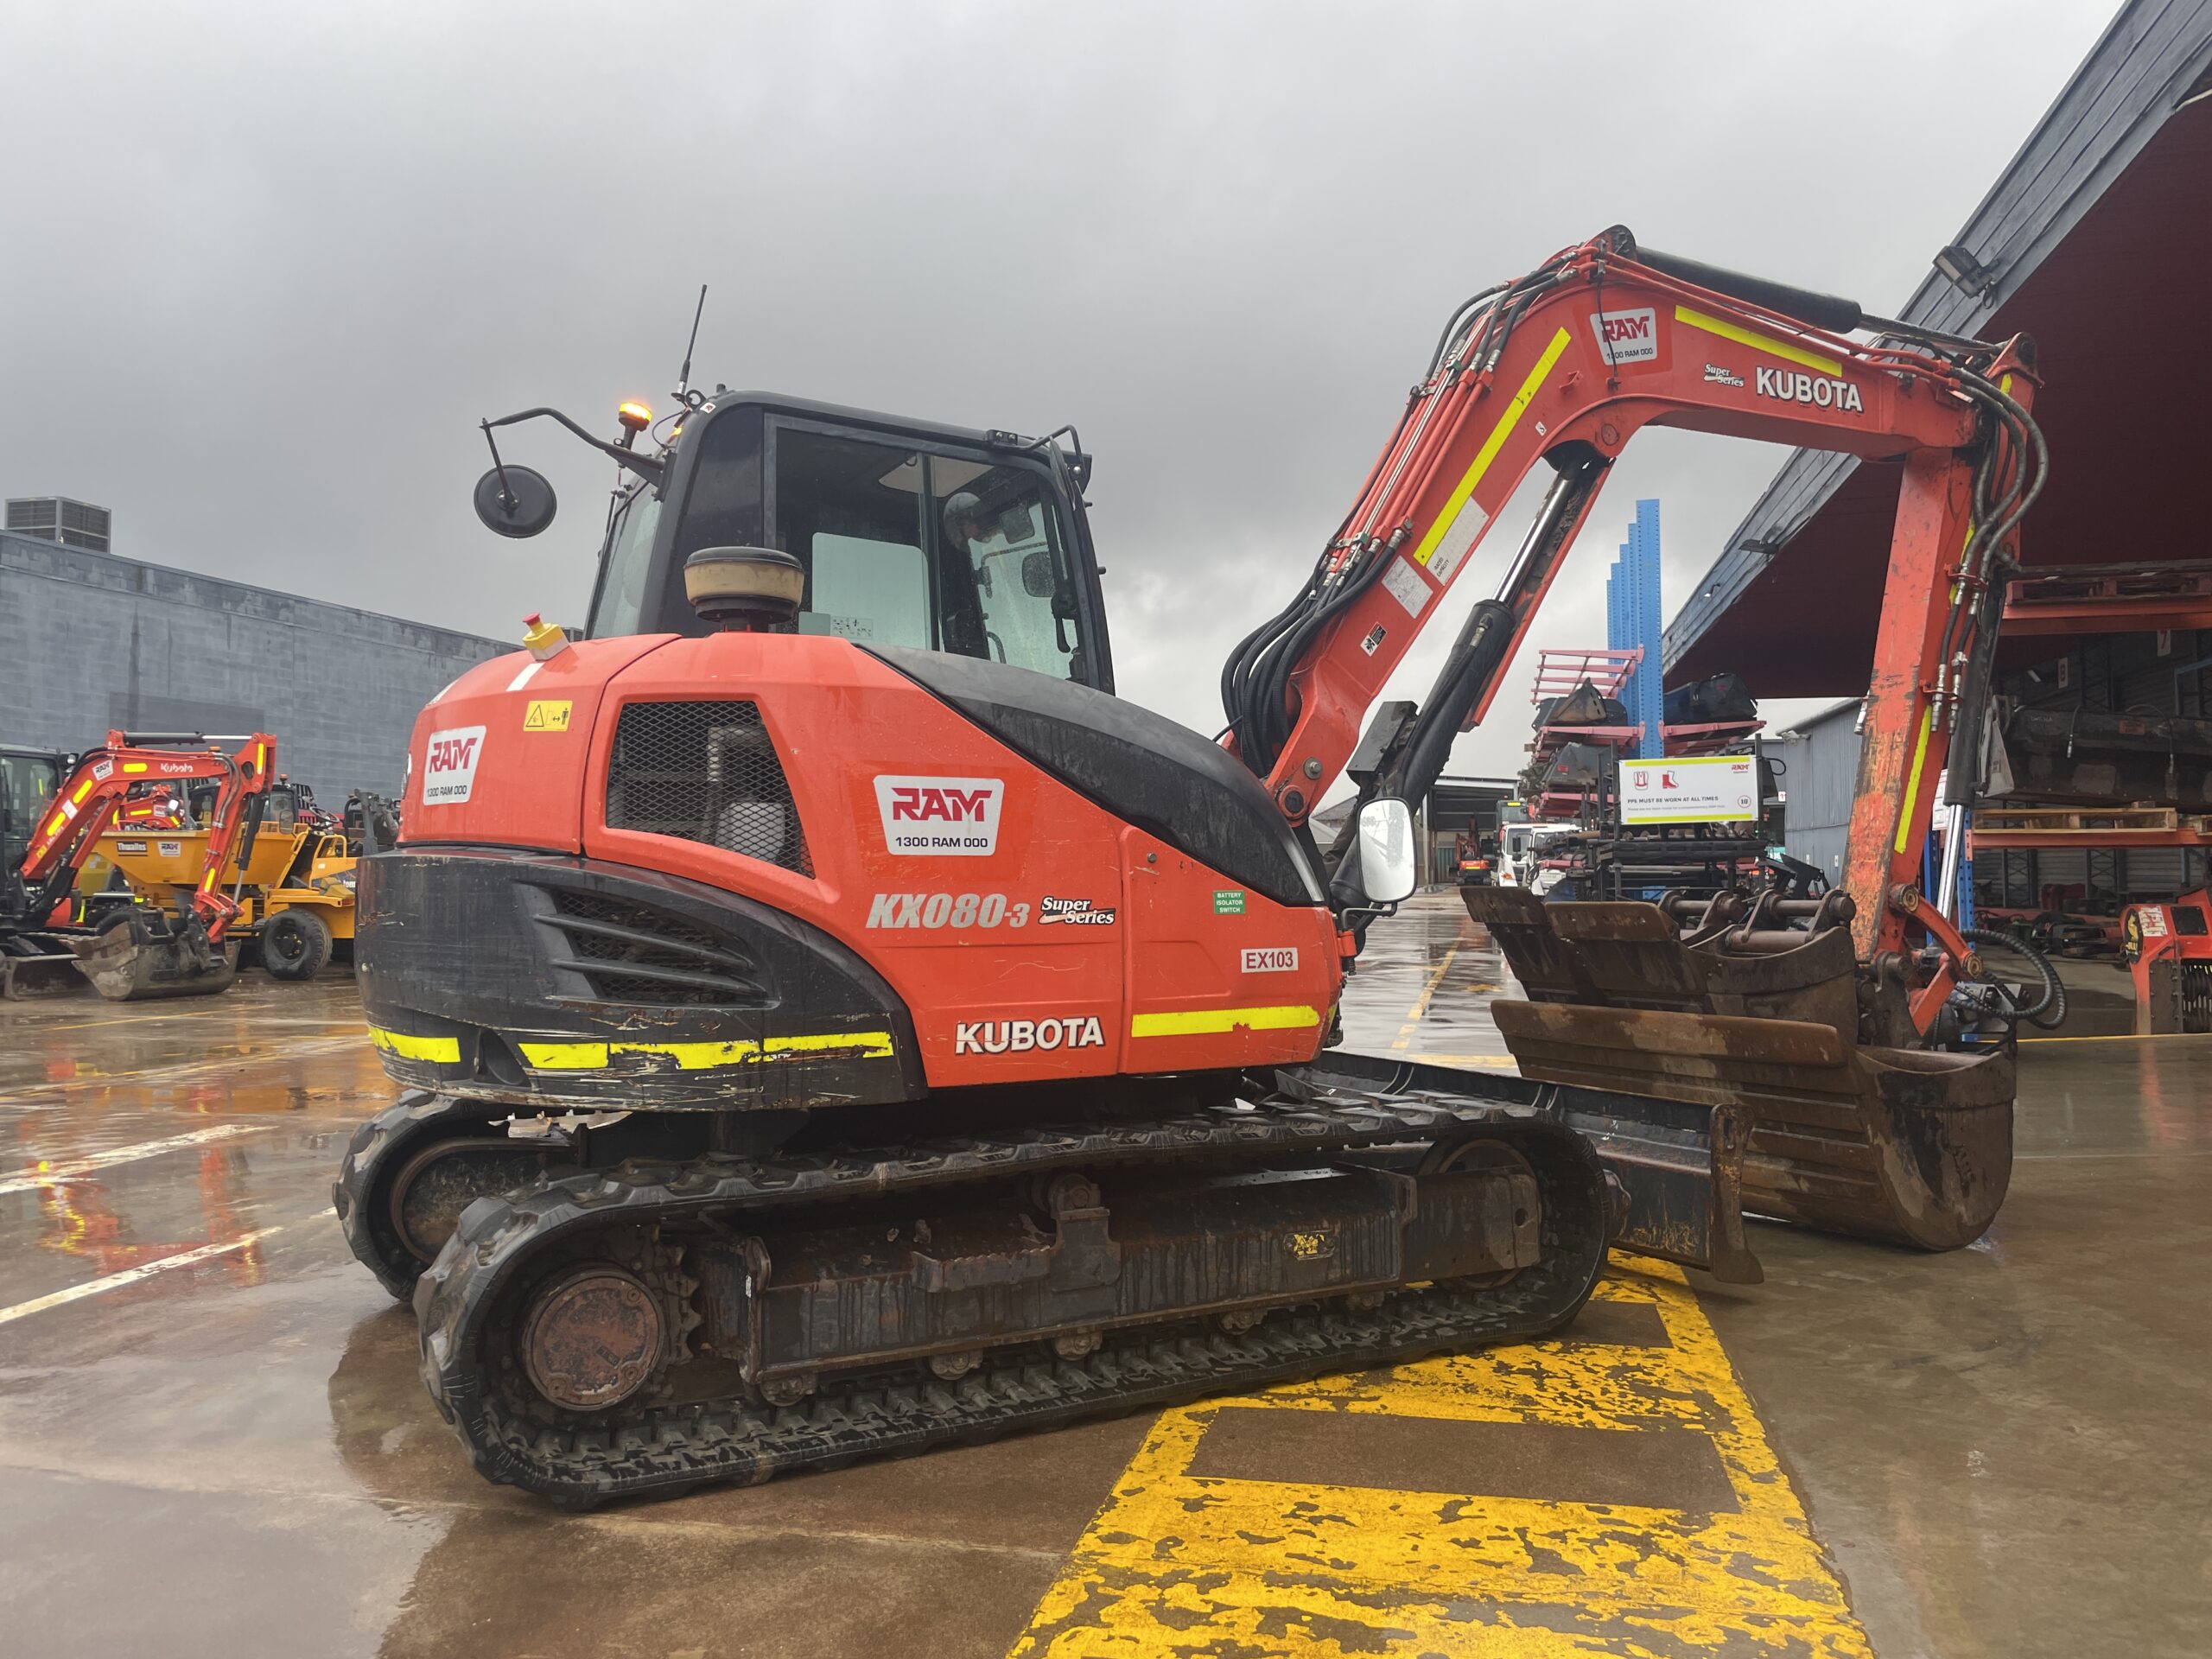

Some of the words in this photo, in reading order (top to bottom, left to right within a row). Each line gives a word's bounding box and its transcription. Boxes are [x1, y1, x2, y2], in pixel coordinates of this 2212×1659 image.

[1600, 315, 1649, 343] RAM
[1624, 349, 1640, 358] RAM
[1641, 347, 1653, 356] 000
[1705, 363, 1731, 377] Super
[1718, 374, 1745, 387] Series
[1756, 366, 1864, 412] KUBOTA
[429, 737, 478, 773] RAM
[161, 763, 194, 772] Kubota
[427, 787, 439, 798] 1300
[440, 785, 454, 796] RAM
[454, 785, 467, 795] 000
[892, 787, 993, 822] RAM
[895, 836, 929, 847] 1300
[931, 837, 961, 848] RAM
[963, 837, 988, 848] 000
[866, 893, 1030, 928] KX080-3
[1041, 896, 1090, 912] Super
[1065, 909, 1115, 925] Series
[1246, 950, 1294, 969] EX103
[955, 1016, 1105, 1054] KUBOTA
